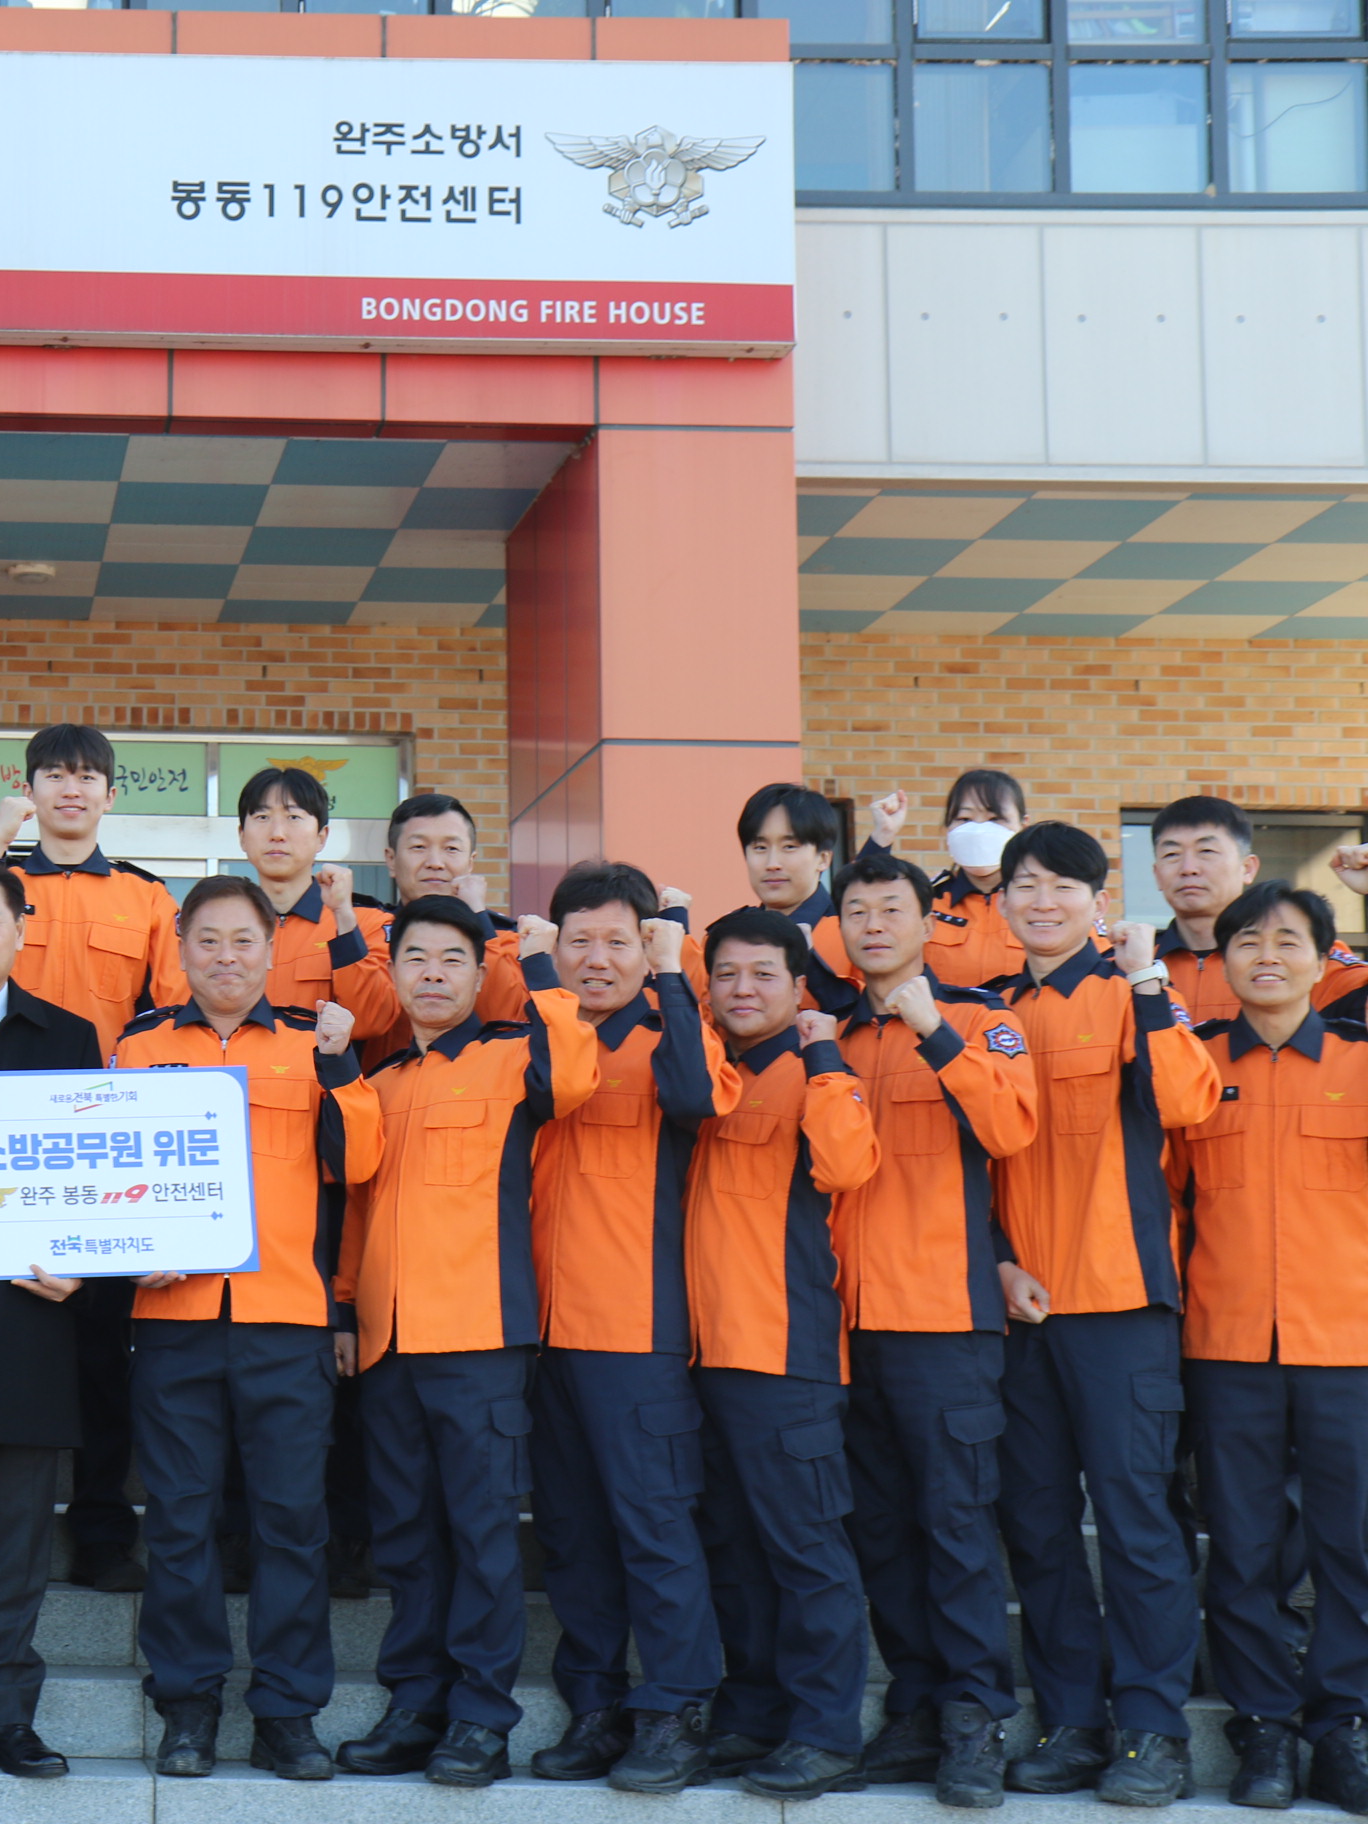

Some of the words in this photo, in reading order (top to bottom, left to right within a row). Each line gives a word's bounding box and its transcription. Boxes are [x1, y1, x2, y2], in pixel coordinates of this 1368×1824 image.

[332, 119, 522, 157] 완주소방서
[170, 179, 523, 226] 봉동119안전센터
[360, 297, 529, 323] BONGDONG
[539, 300, 598, 323] FIRE
[608, 301, 706, 325] HOUSE
[115, 764, 189, 795] 국민안전
[153, 1128, 220, 1168] 위문
[20, 1186, 56, 1206] 완주
